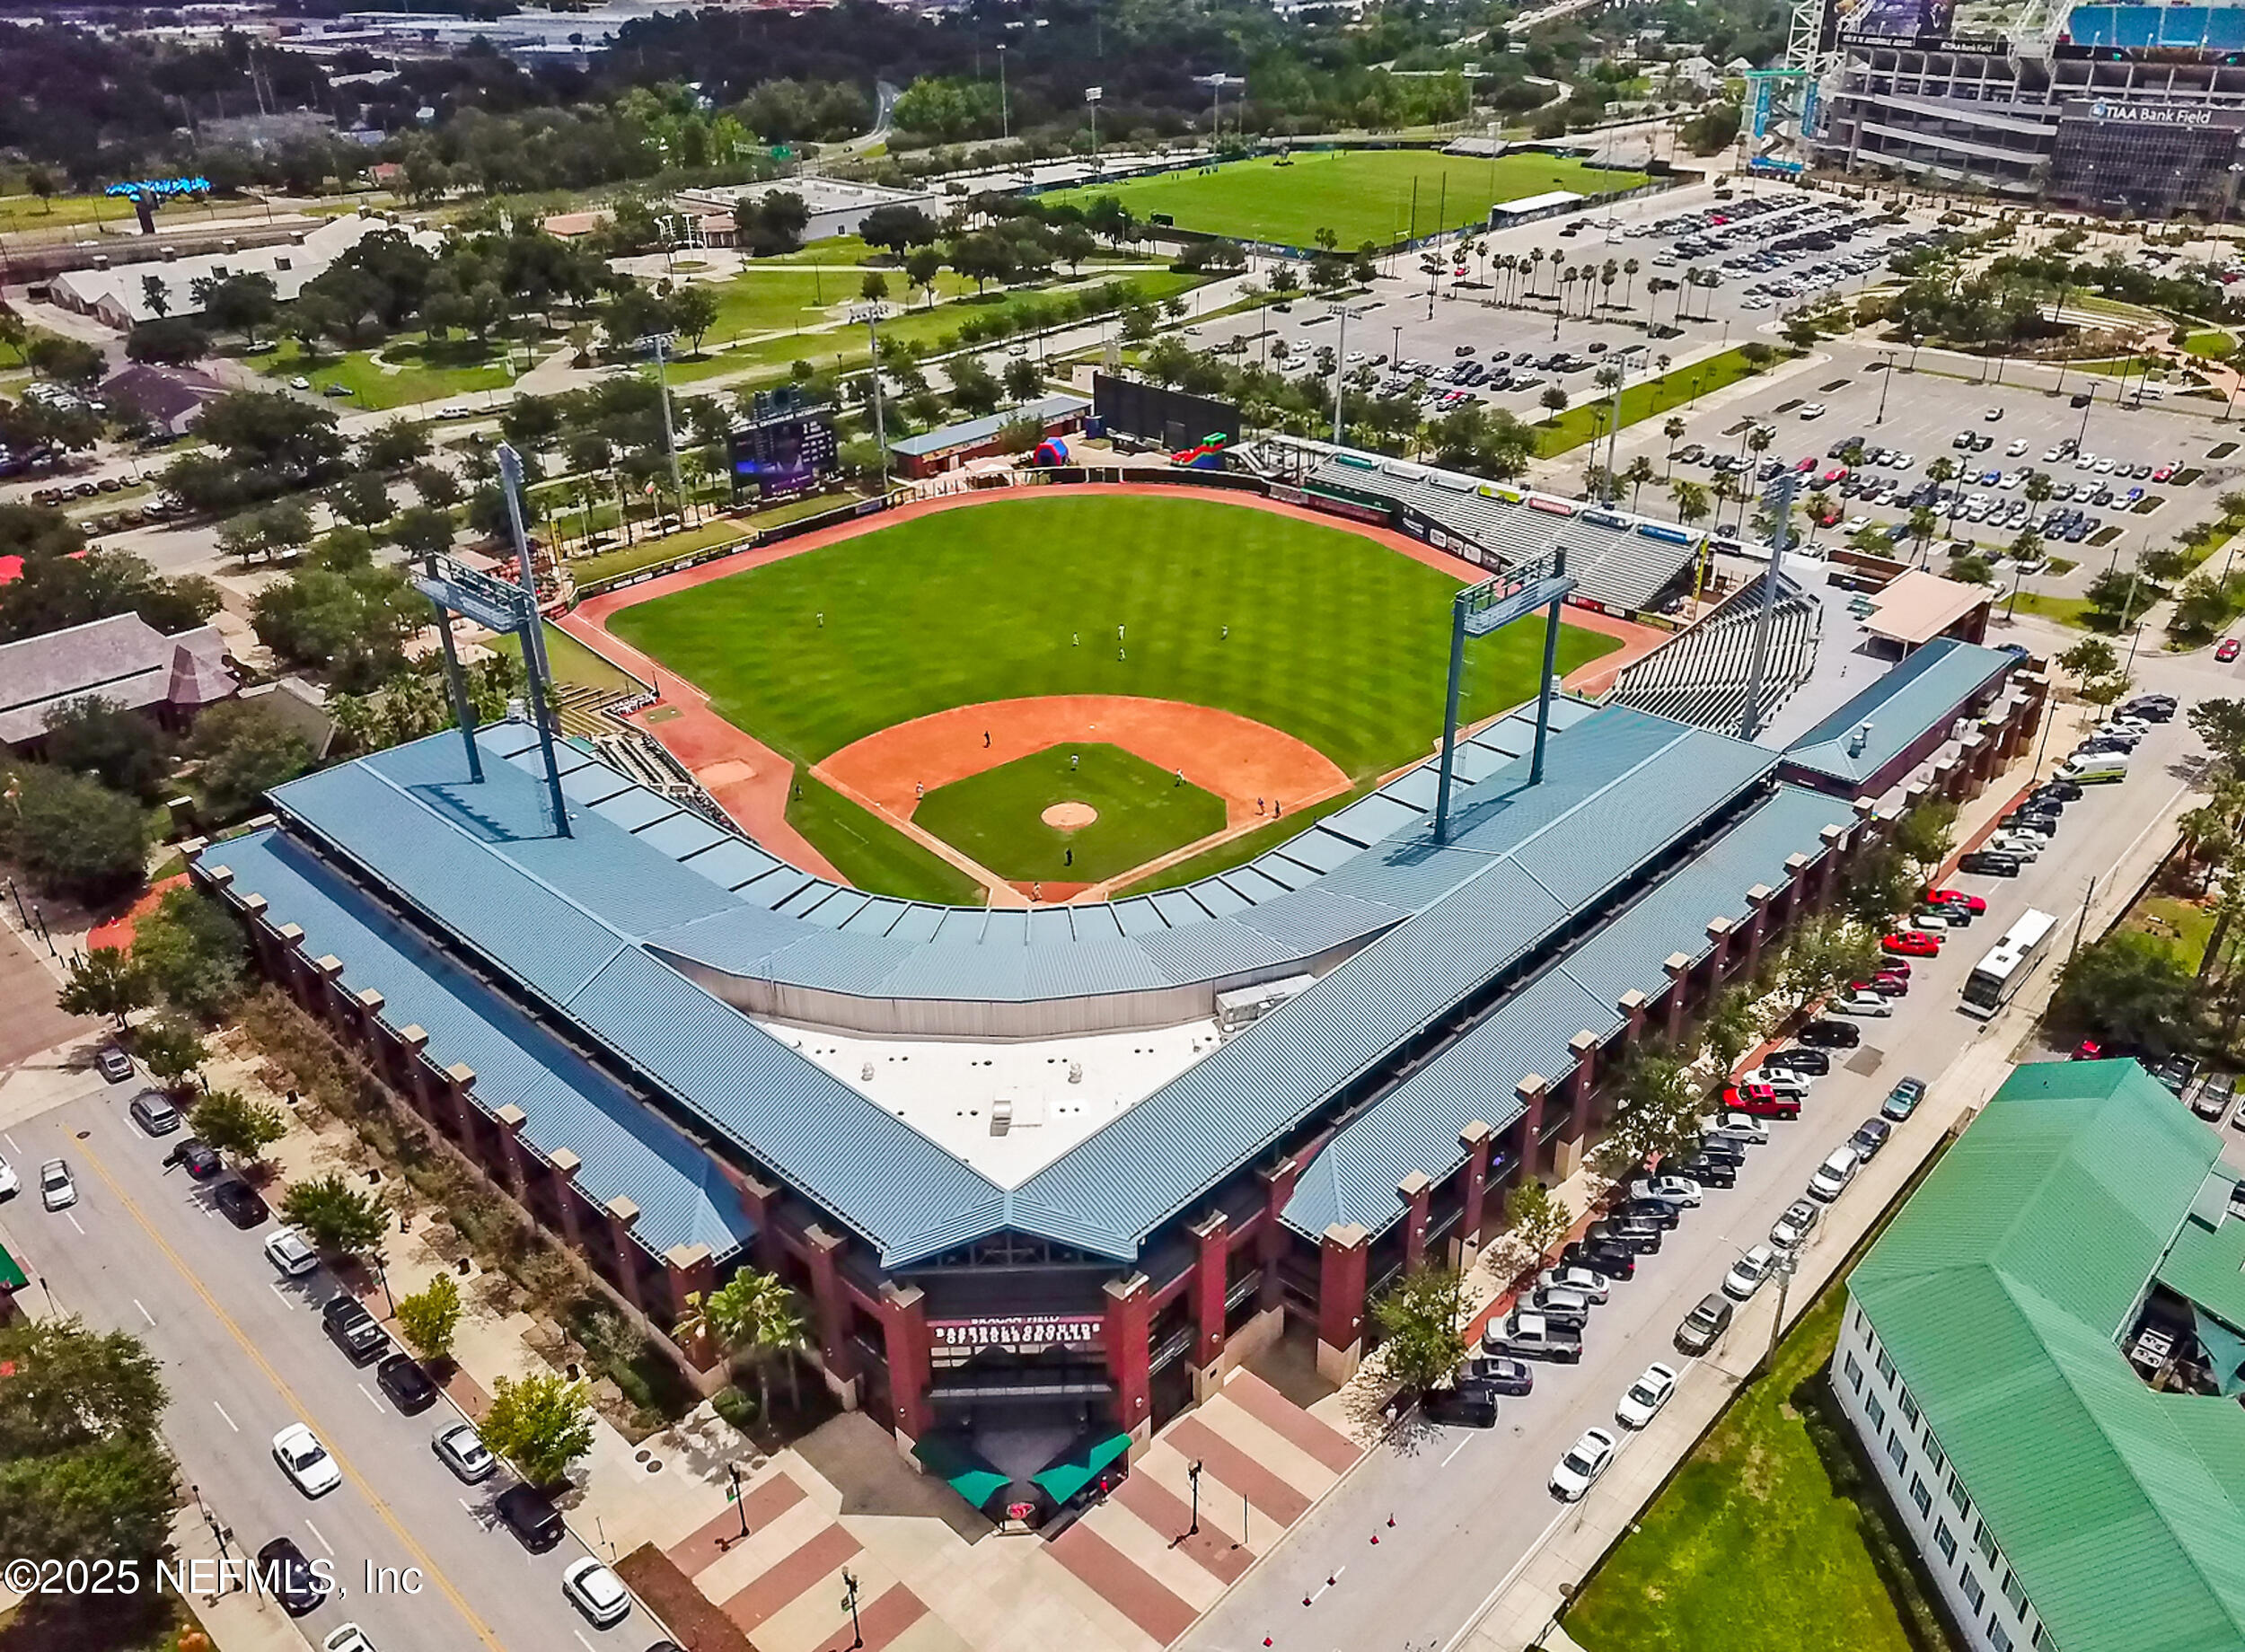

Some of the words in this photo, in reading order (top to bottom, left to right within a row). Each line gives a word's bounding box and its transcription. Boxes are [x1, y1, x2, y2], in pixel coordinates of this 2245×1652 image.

[2106, 106, 2137, 120] TIAA
[2140, 108, 2175, 122] Bank
[2176, 110, 2212, 124] Field
